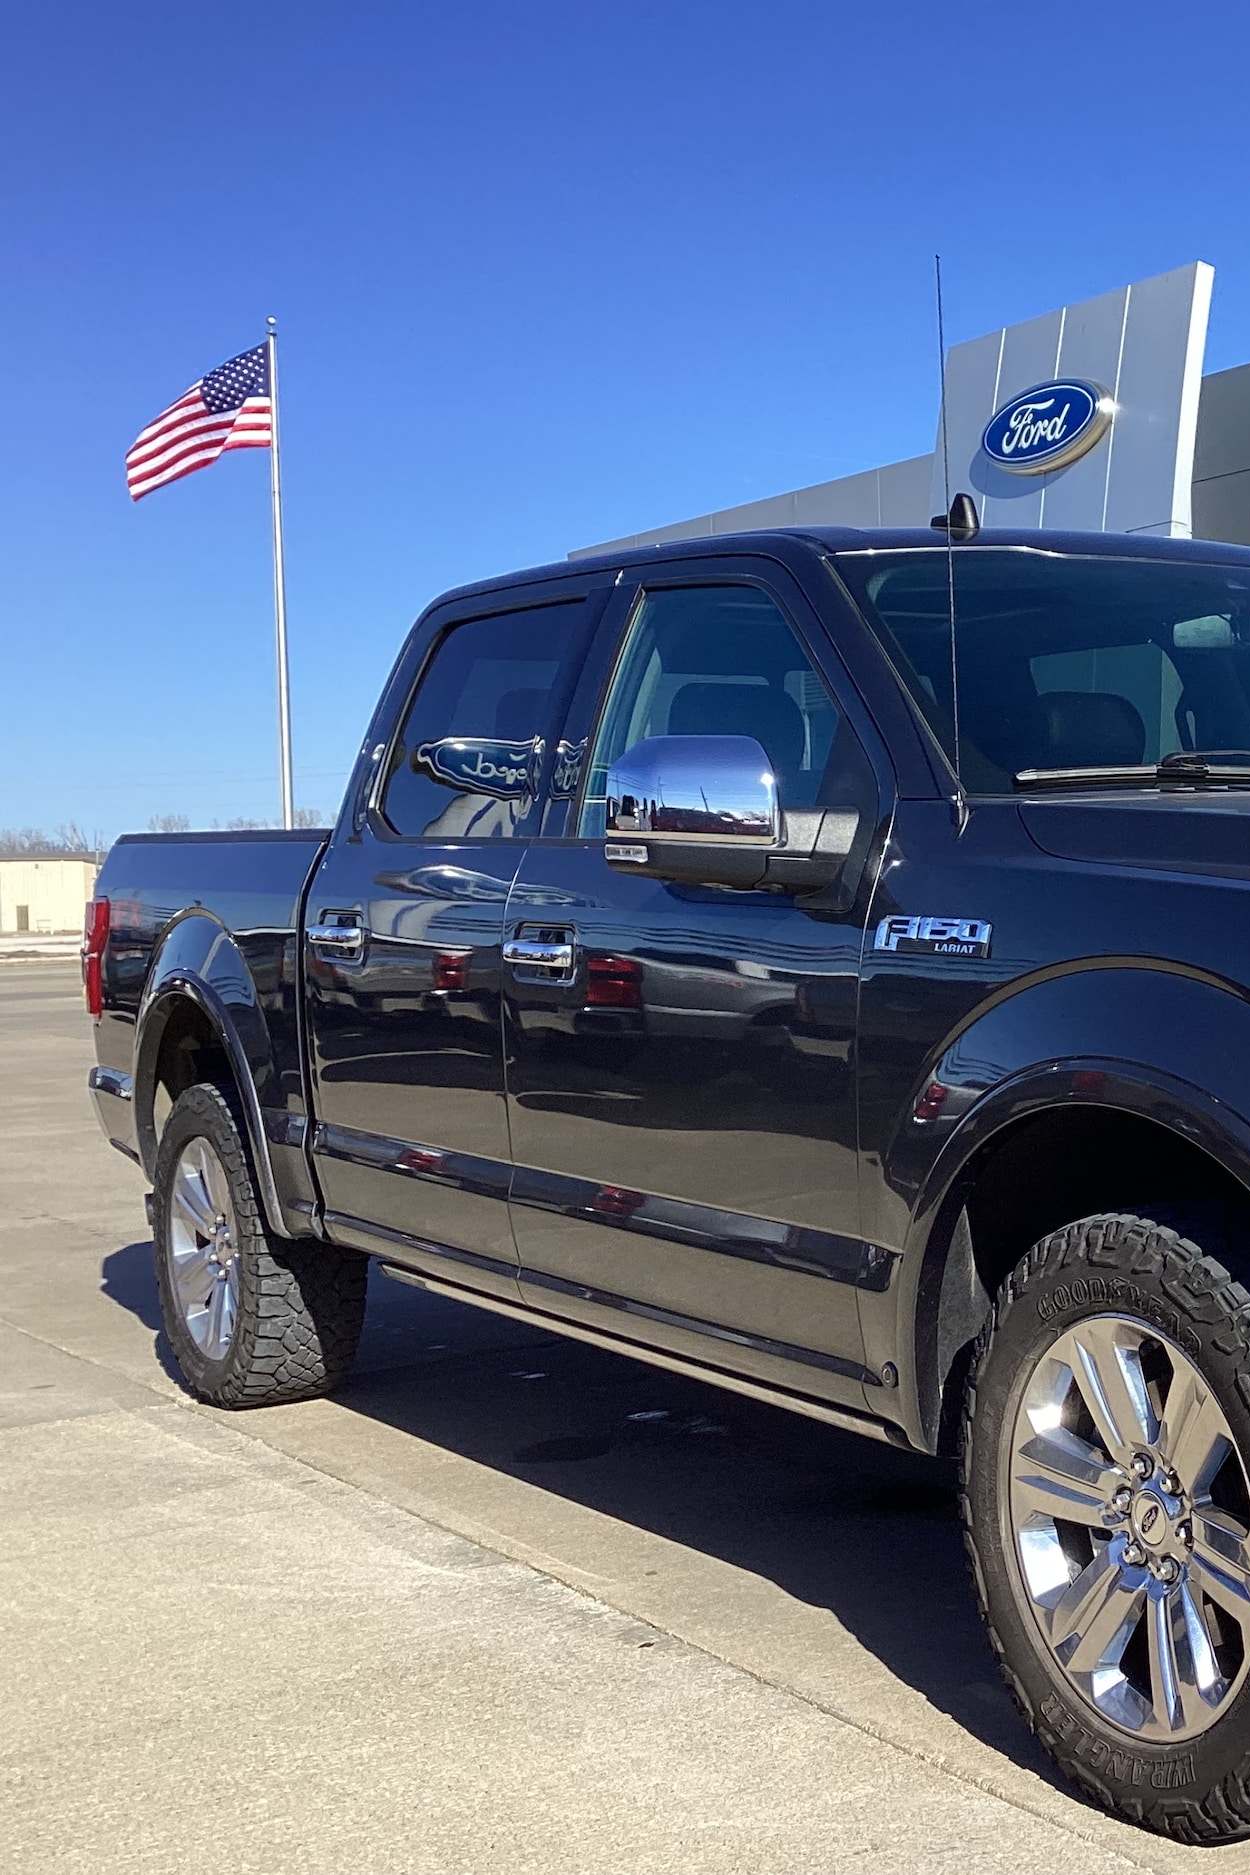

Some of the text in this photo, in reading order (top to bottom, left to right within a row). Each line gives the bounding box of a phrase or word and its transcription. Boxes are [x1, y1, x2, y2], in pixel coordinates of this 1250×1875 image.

[1002, 398, 1070, 454] Ford
[934, 943, 976, 954] LARIAT
[1040, 1690, 1196, 1789] WRANGLER
